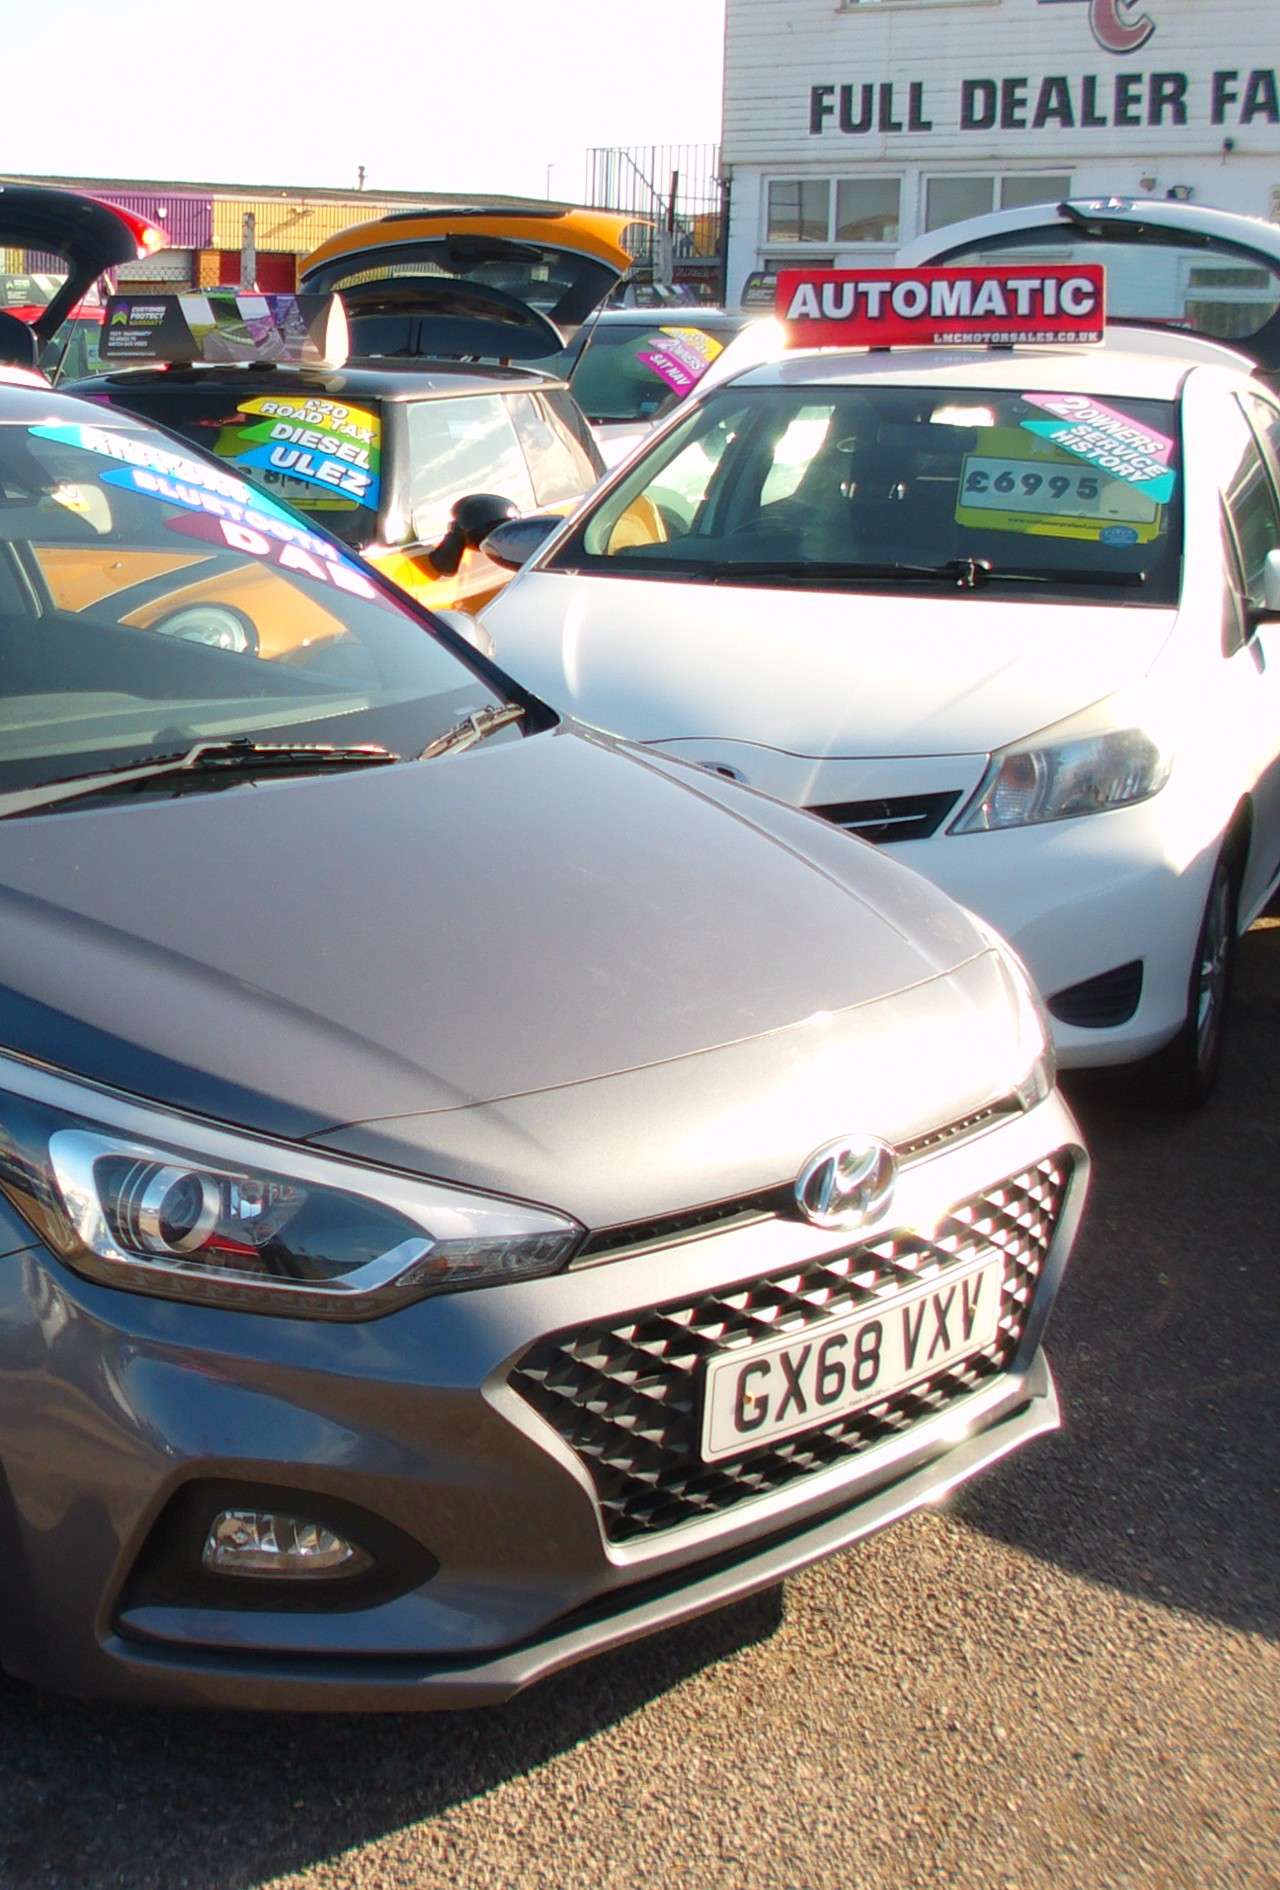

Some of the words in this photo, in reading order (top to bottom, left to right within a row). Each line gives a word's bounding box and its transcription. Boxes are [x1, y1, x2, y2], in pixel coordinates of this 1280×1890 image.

[809, 81, 933, 135] FULL
[960, 72, 1188, 131] DEALER
[787, 279, 1095, 320] AUTOMATIC
[933, 331, 1099, 344] LMCMOTORSALES.CO.UK
[261, 402, 323, 425] ROAD
[330, 418, 377, 444] TAX
[270, 423, 371, 471] DIESEL
[1043, 396, 1091, 415] 2
[1073, 408, 1166, 455] OWNERS
[270, 446, 372, 498] ULEZ
[1048, 430, 1151, 483] HISTORY
[1070, 425, 1169, 478] SERVICE
[965, 470, 1099, 500] £6995
[132, 470, 340, 562] BLUETOOTH
[219, 519, 377, 600] DAB
[733, 1319, 884, 1434] GX68
[902, 1272, 985, 1371] VXV
